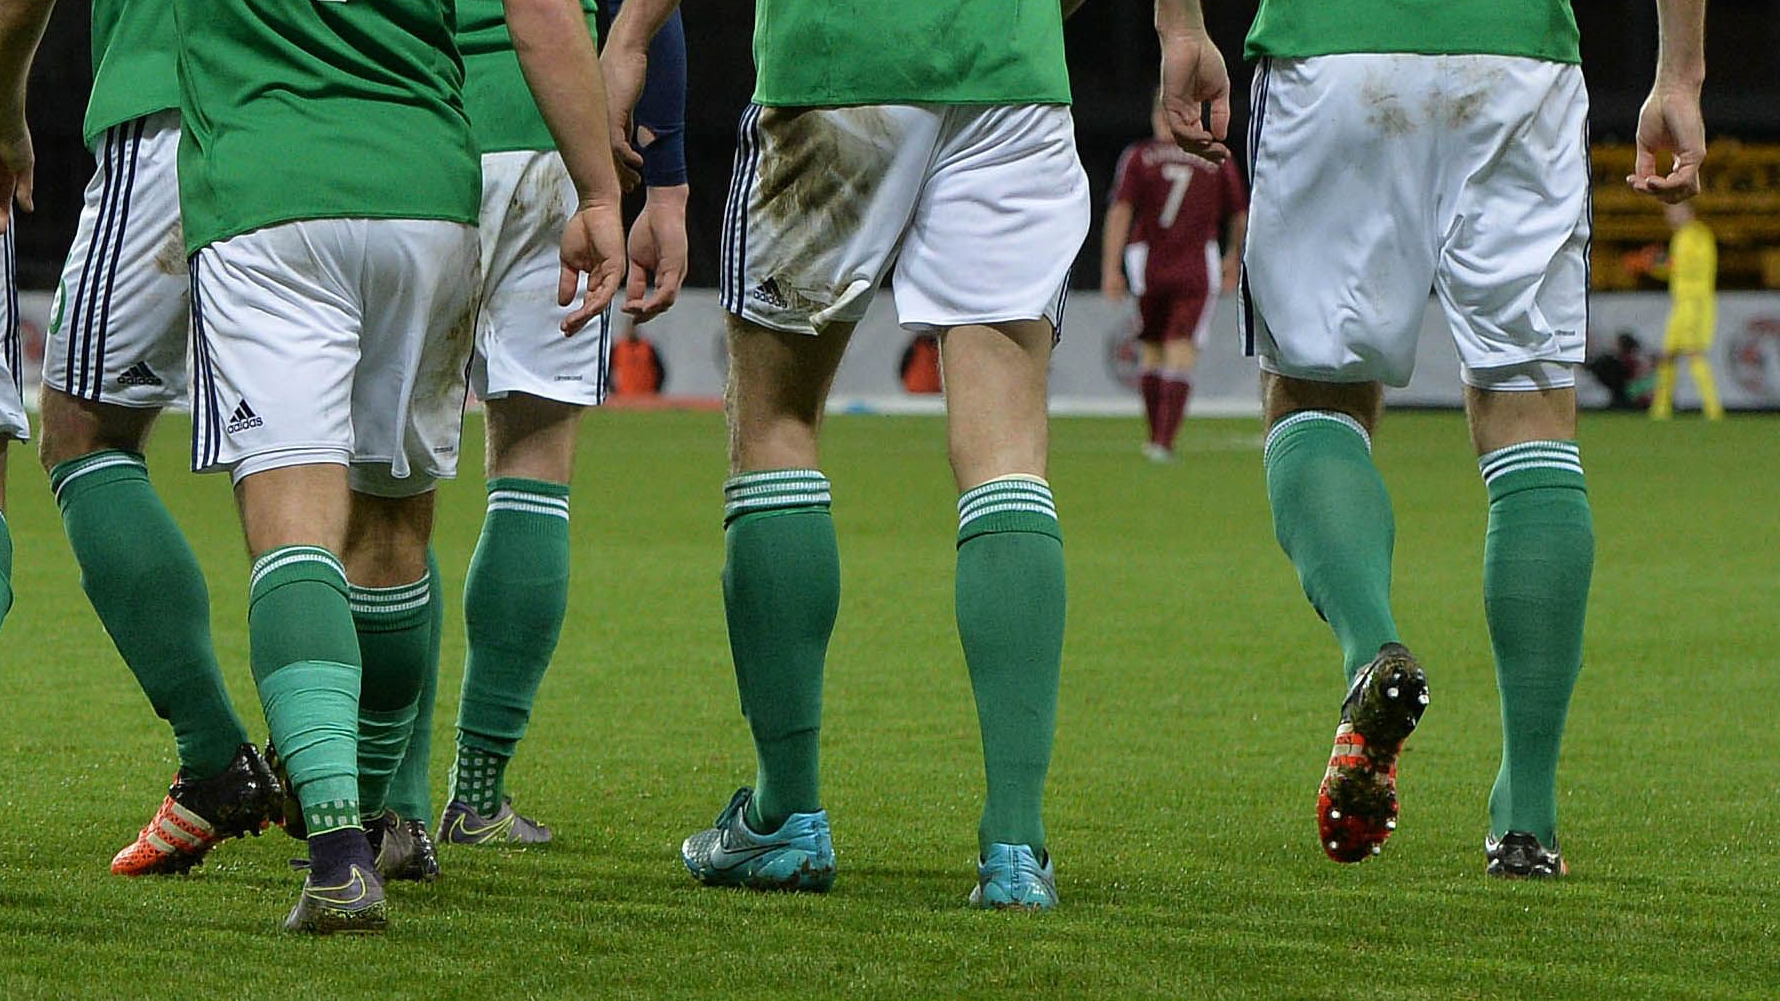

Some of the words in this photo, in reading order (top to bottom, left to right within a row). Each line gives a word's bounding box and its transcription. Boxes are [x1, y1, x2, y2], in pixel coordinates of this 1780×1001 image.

[1159, 163, 1194, 229] 7
[116, 376, 163, 387] adidas
[227, 416, 264, 434] adidas
